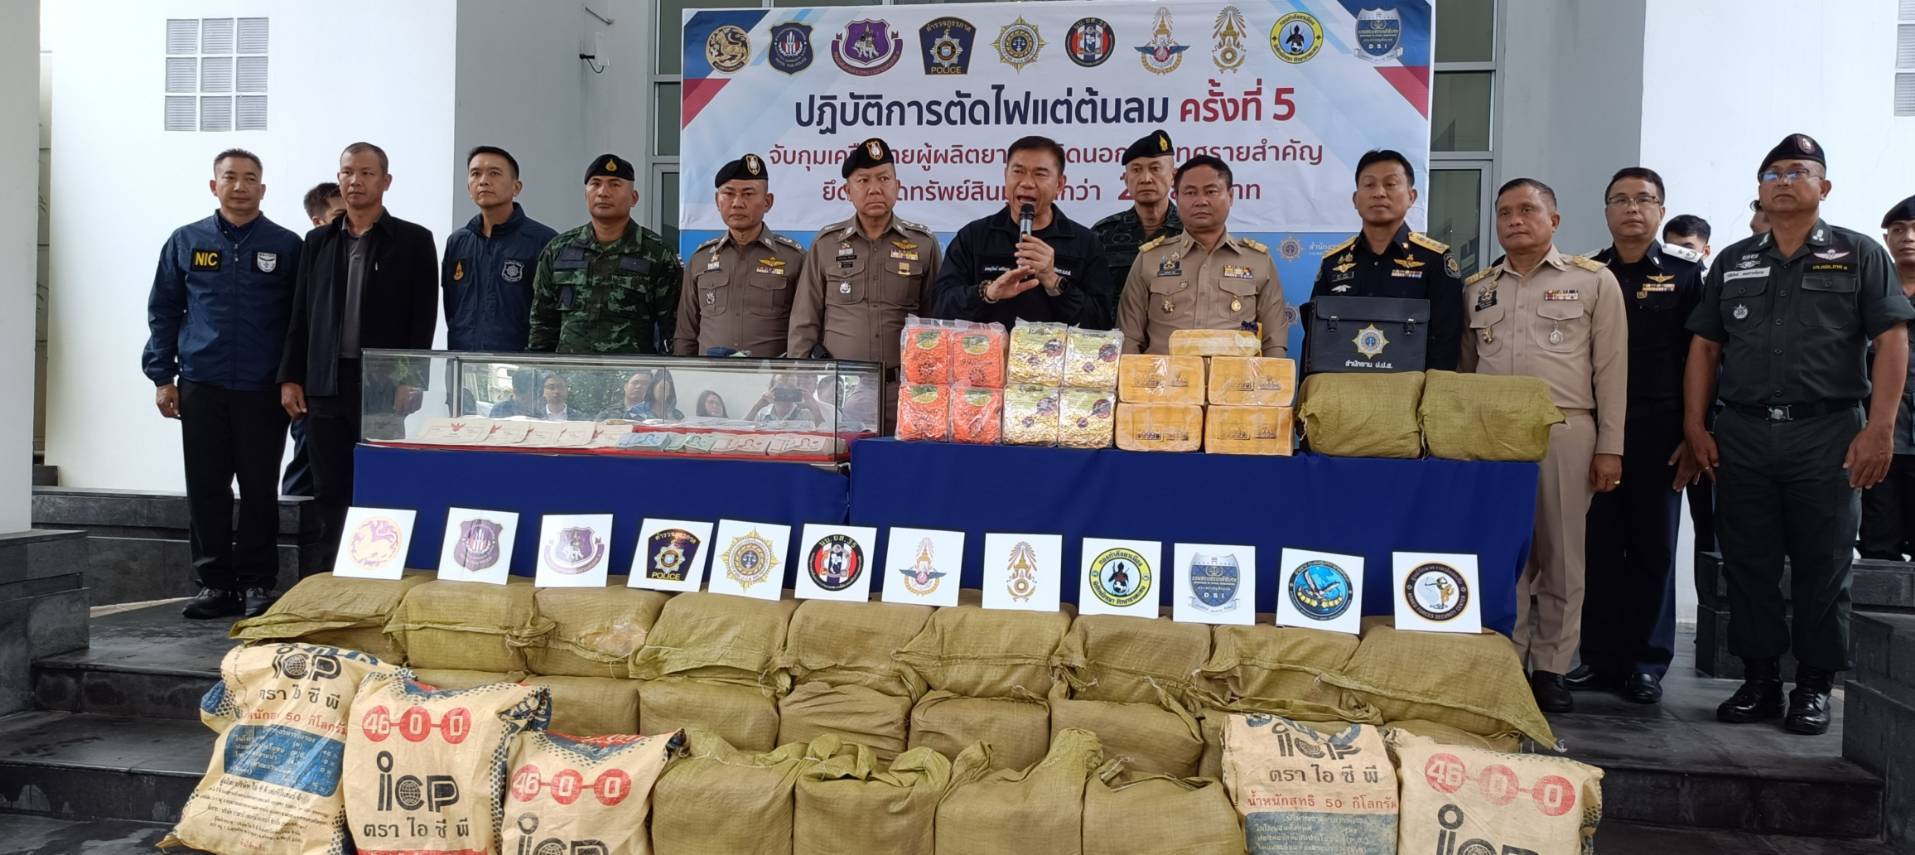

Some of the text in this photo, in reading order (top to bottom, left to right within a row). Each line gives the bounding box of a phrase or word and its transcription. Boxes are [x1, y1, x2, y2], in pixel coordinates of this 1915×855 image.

[930, 66, 962, 74] POLICE
[795, 79, 1297, 134] ปฏิบัติการตัดไฟแต่ต้นลม ครั้งที่ 5
[195, 252, 218, 266] NIC
[651, 571, 681, 581] POLICE
[286, 712, 301, 722] 50
[1269, 764, 1378, 783] ตรา ไอ ซี พี
[1325, 799, 1343, 808] 50
[363, 823, 399, 838] ตรา
[406, 816, 428, 837] ไอ
[456, 818, 469, 837] พี
